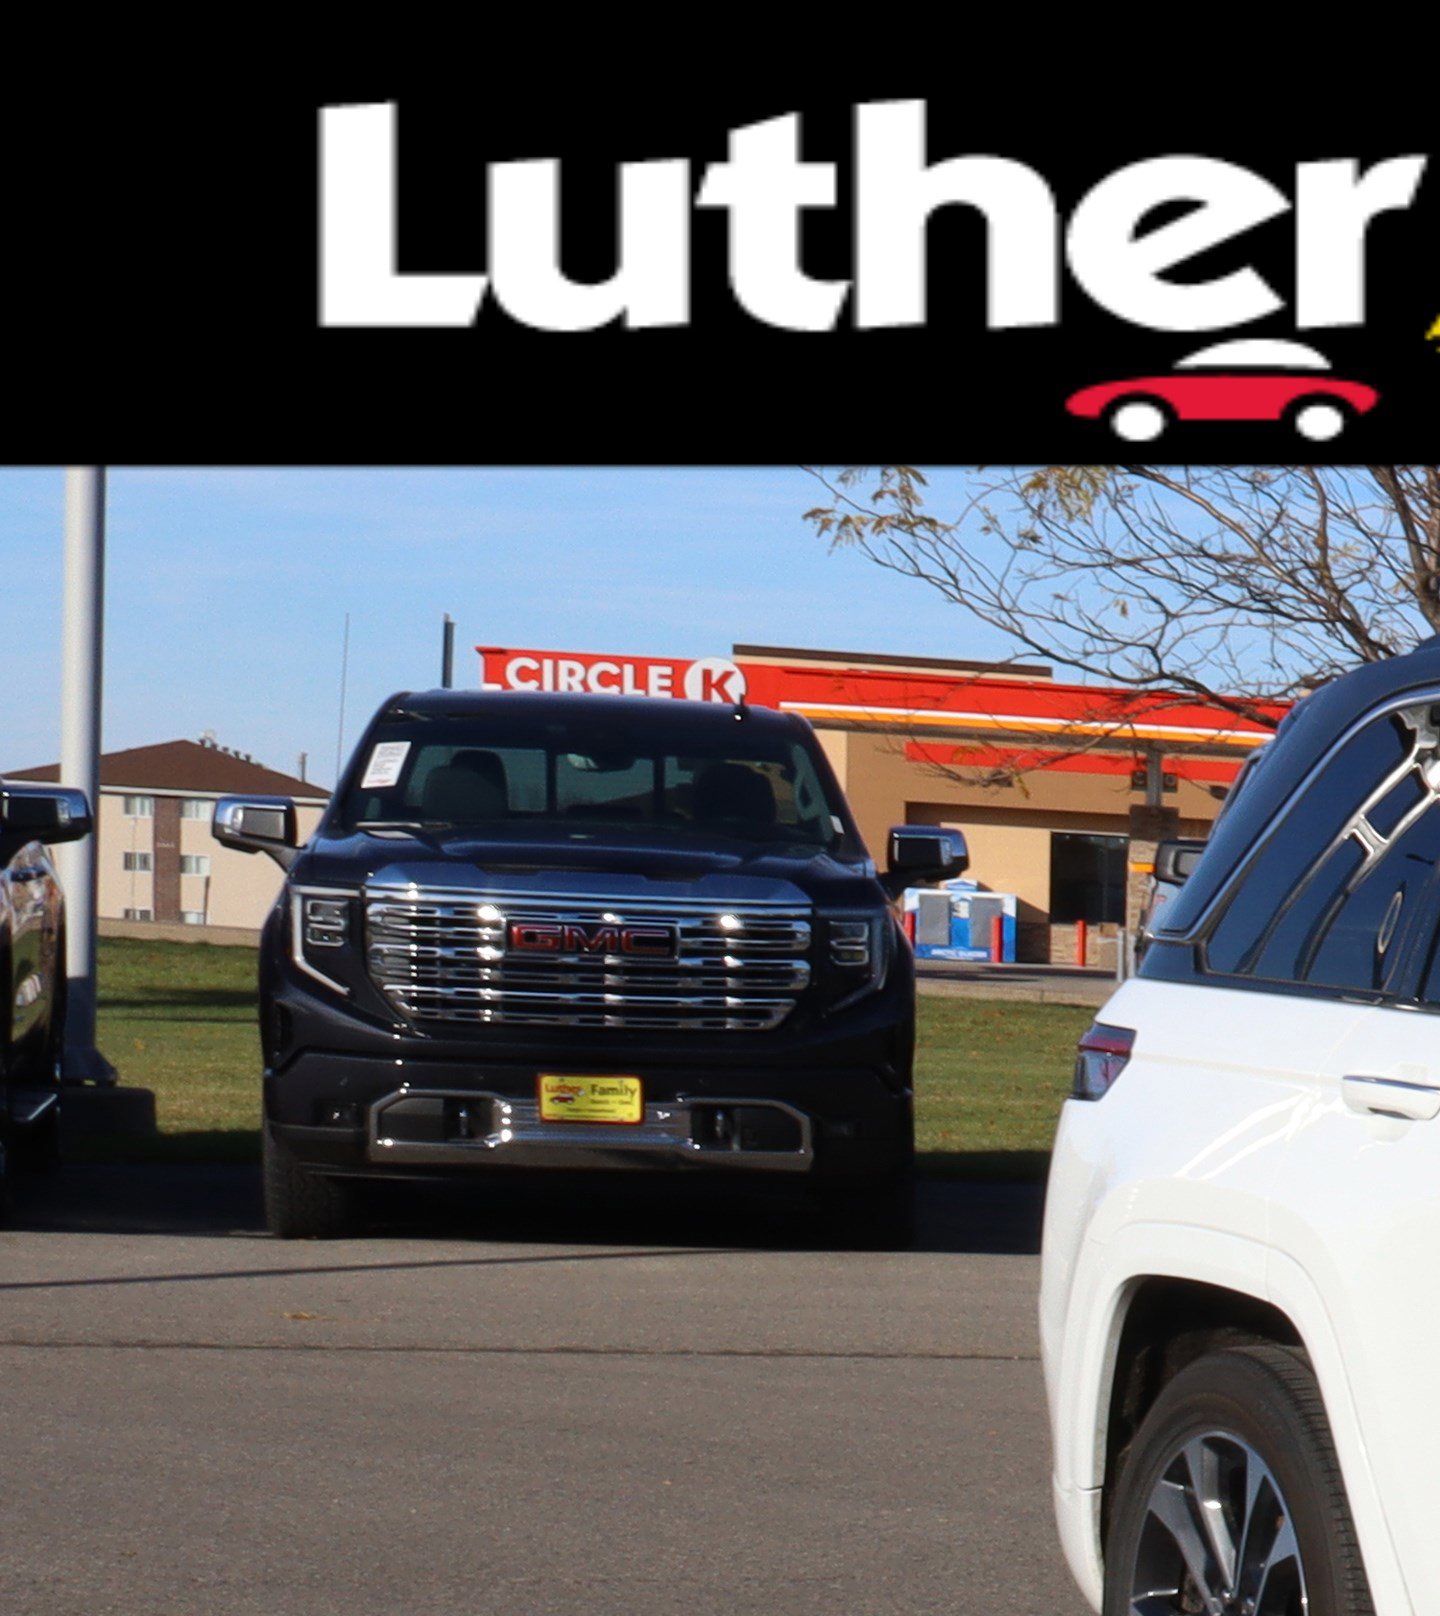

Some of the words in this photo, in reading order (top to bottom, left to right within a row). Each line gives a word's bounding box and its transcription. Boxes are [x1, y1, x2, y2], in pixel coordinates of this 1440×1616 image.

[505, 656, 674, 699] CIRCLE
[702, 668, 738, 705] K
[511, 922, 671, 955] GMC
